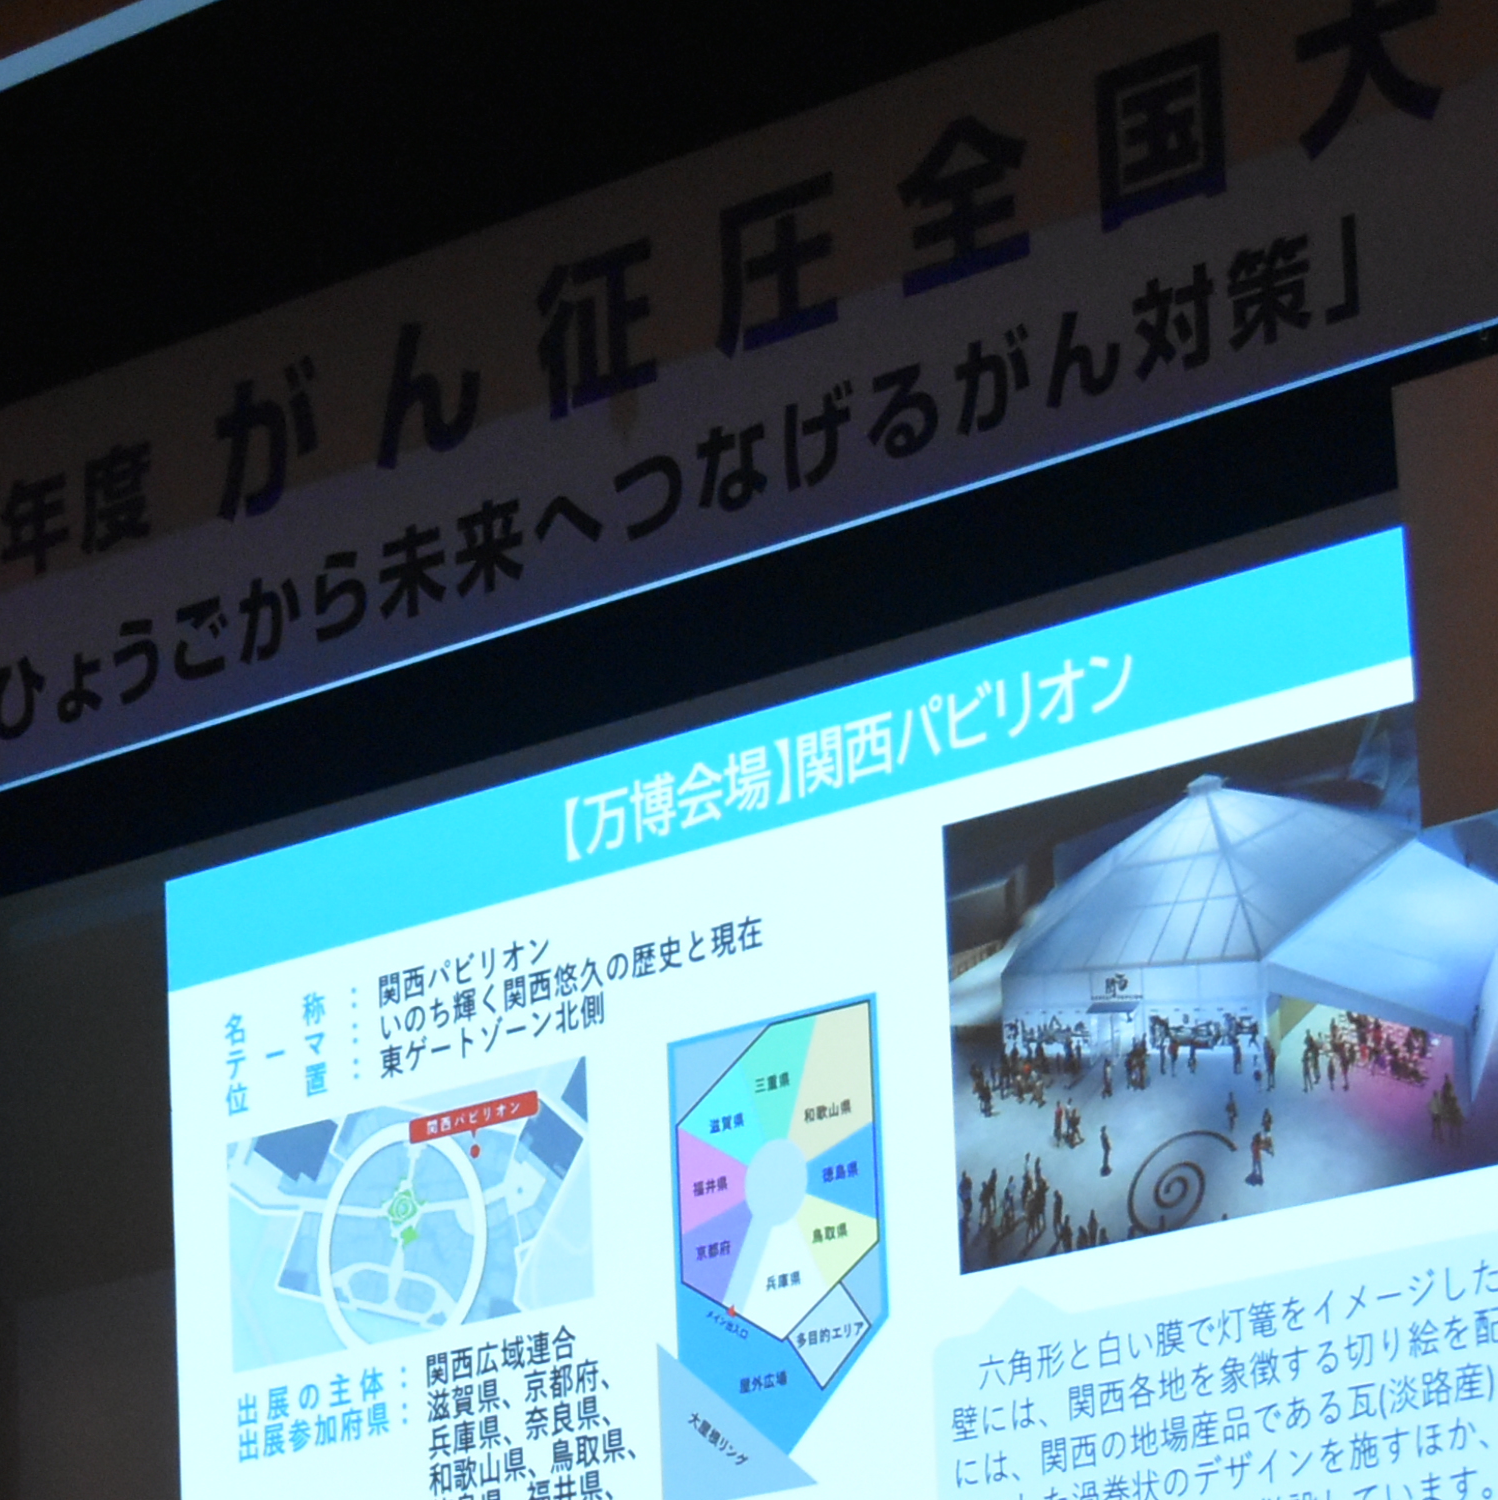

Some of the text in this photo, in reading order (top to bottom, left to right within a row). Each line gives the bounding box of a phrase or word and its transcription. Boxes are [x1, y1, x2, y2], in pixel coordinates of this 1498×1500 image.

[563, 653, 1134, 863] 【万博会場】関西パビリオン
[378, 937, 550, 1009] 関西パビリオン
[380, 916, 763, 1042] いのち輝く関西悠久の歴史と現在
[379, 991, 605, 1082] 東ゲートゾーン北側
[754, 1071, 791, 1094] 三重県
[426, 1101, 521, 1136] 関西パビリオン
[708, 1112, 745, 1135] 滋賀県
[803, 1098, 852, 1124] 和歌山県
[692, 1175, 729, 1198] 福井県
[821, 1160, 860, 1184] 徳島県
[811, 1222, 849, 1245] 鳥取県
[695, 1239, 732, 1262] 京都府
[765, 1270, 802, 1293] 兵庫県
[796, 1320, 865, 1350] 多目的エリア
[425, 1324, 577, 1390] 関西広域連合
[426, 1357, 611, 1424] 滋賀県、京都府、
[739, 1369, 788, 1395] 屋外広場
[427, 1394, 613, 1461] 兵庫県、奈良県、
[687, 1411, 750, 1467] 大屋根リング
[428, 1427, 637, 1498] 和歌山県、鳥取県、
